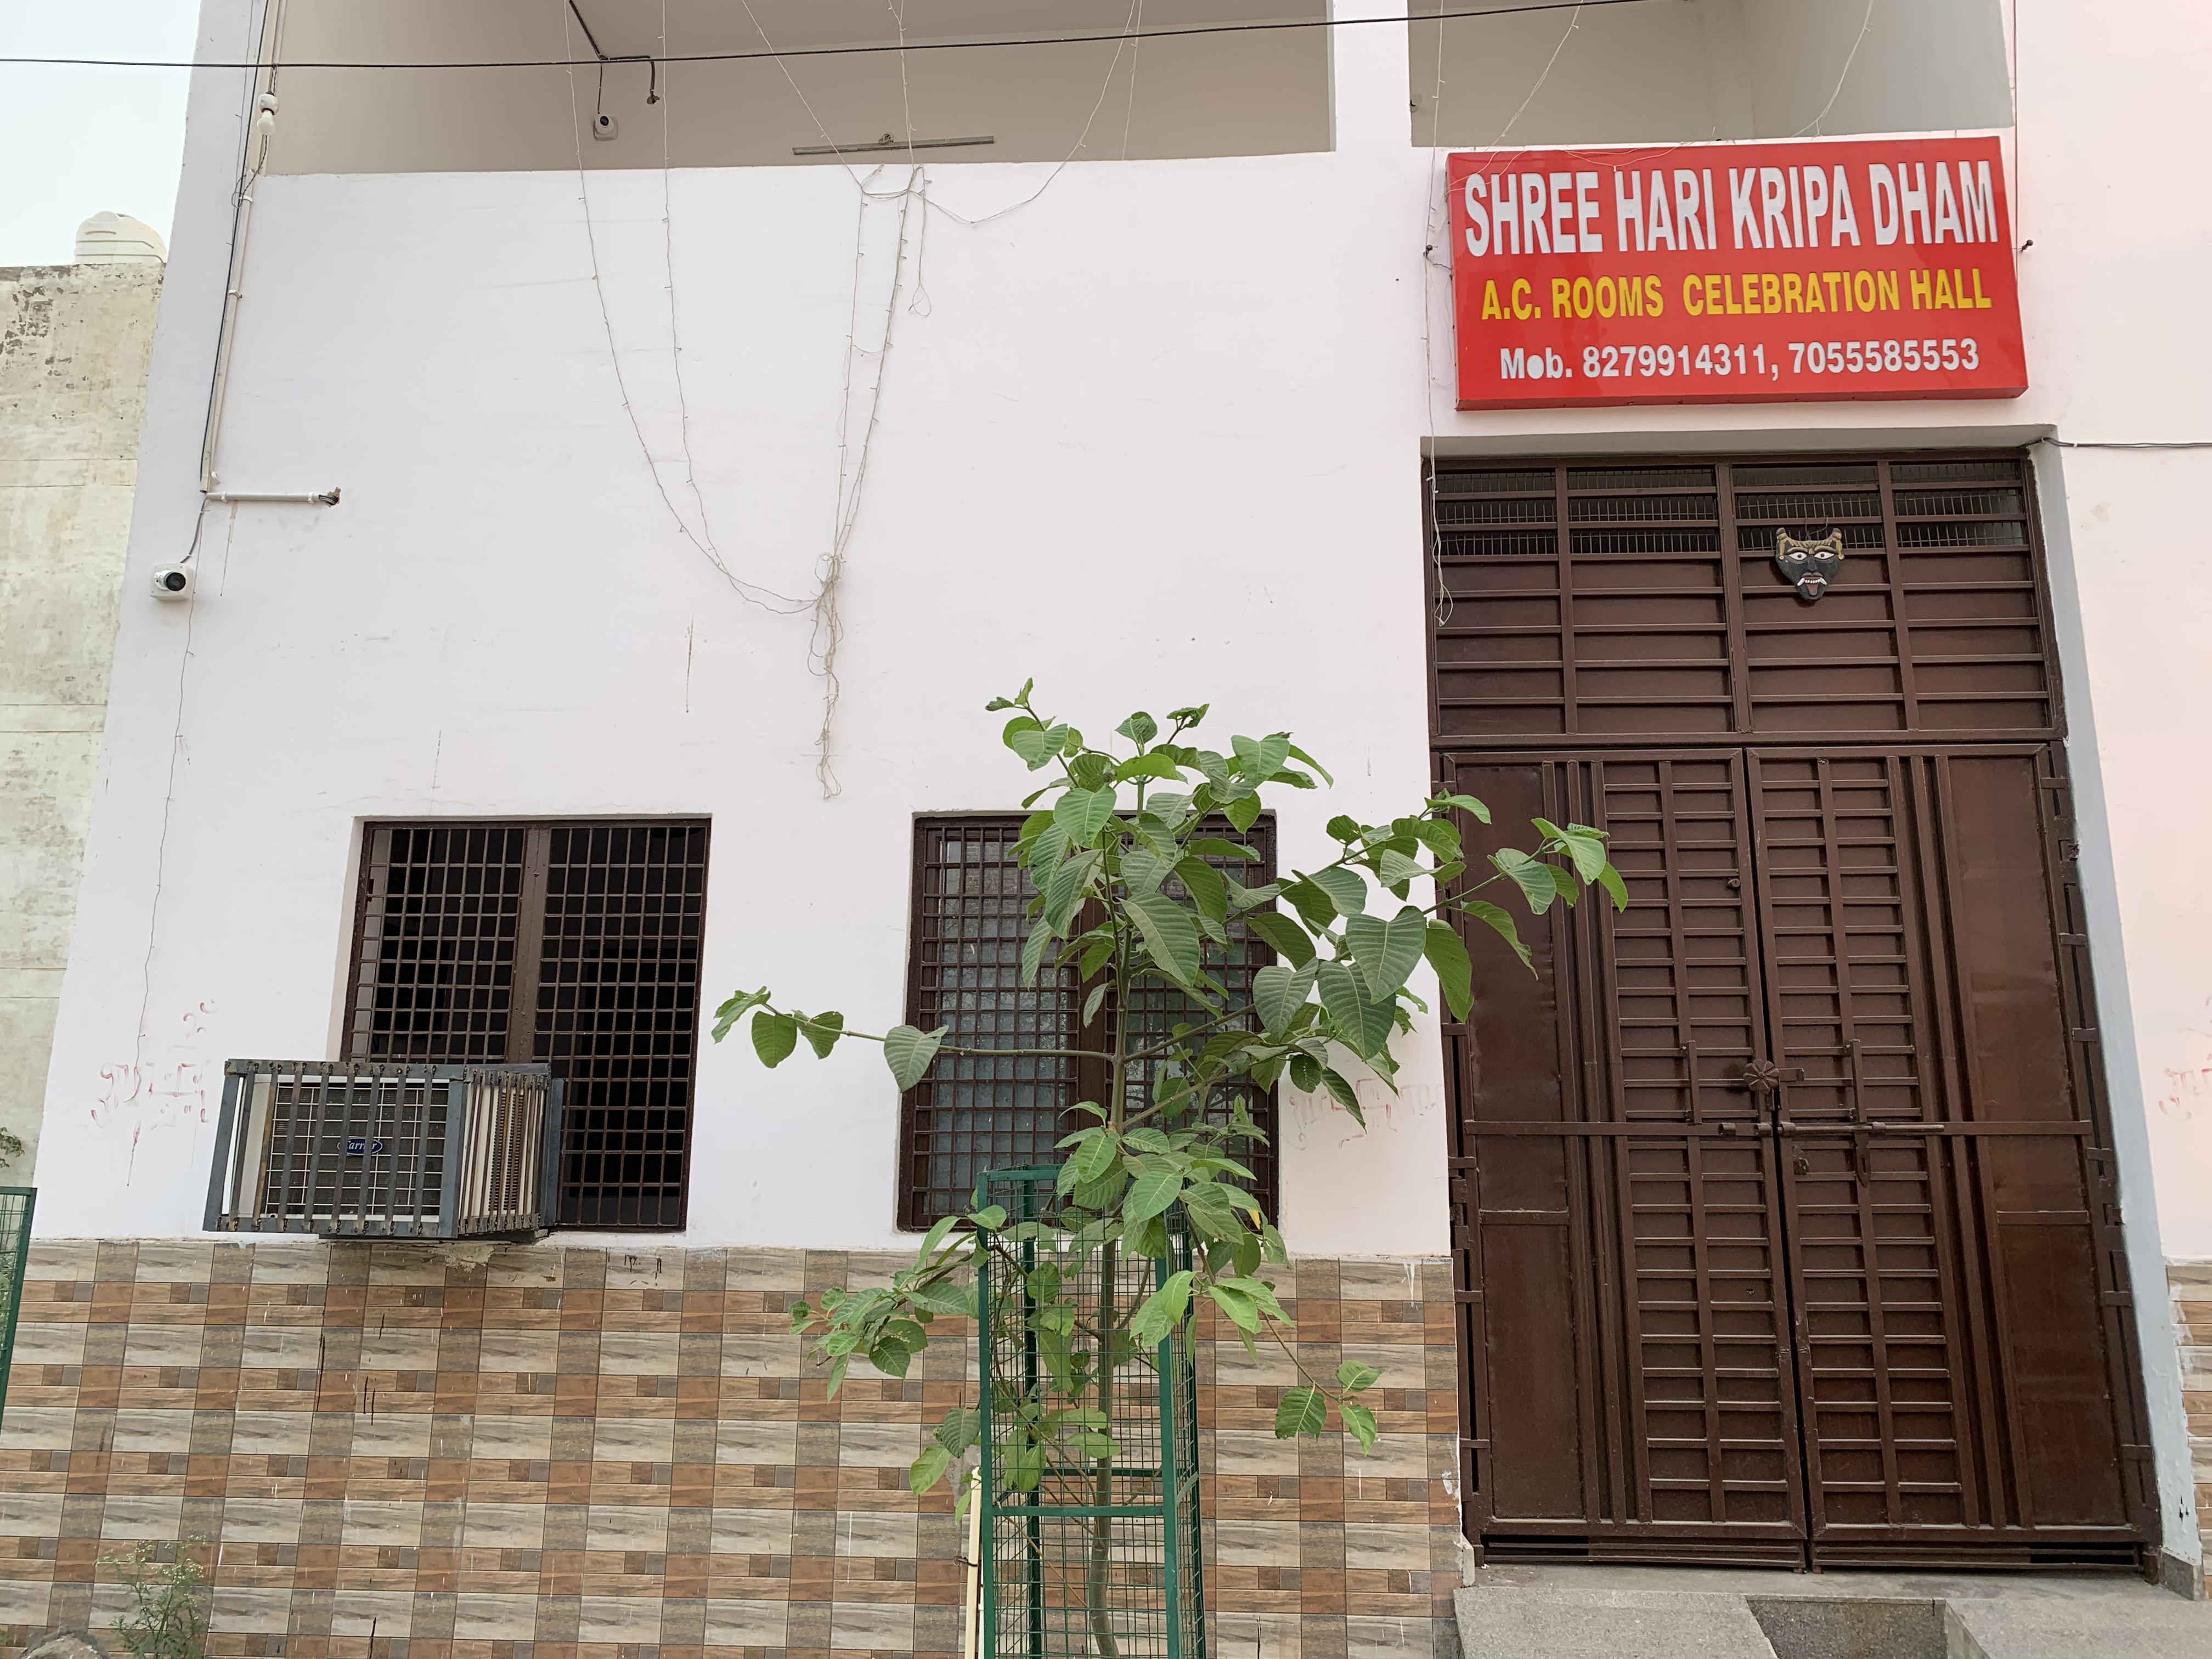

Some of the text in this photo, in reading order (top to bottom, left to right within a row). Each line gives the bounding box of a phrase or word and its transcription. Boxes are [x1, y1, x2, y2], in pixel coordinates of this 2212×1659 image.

[1465, 161, 1998, 257] SHREE HARI KRIPA DHAM
[1482, 268, 1991, 320] A.C. ROOMS CELEBRATION HALL
[1501, 338, 1979, 381] Mob. 8279914311, 7055585553
